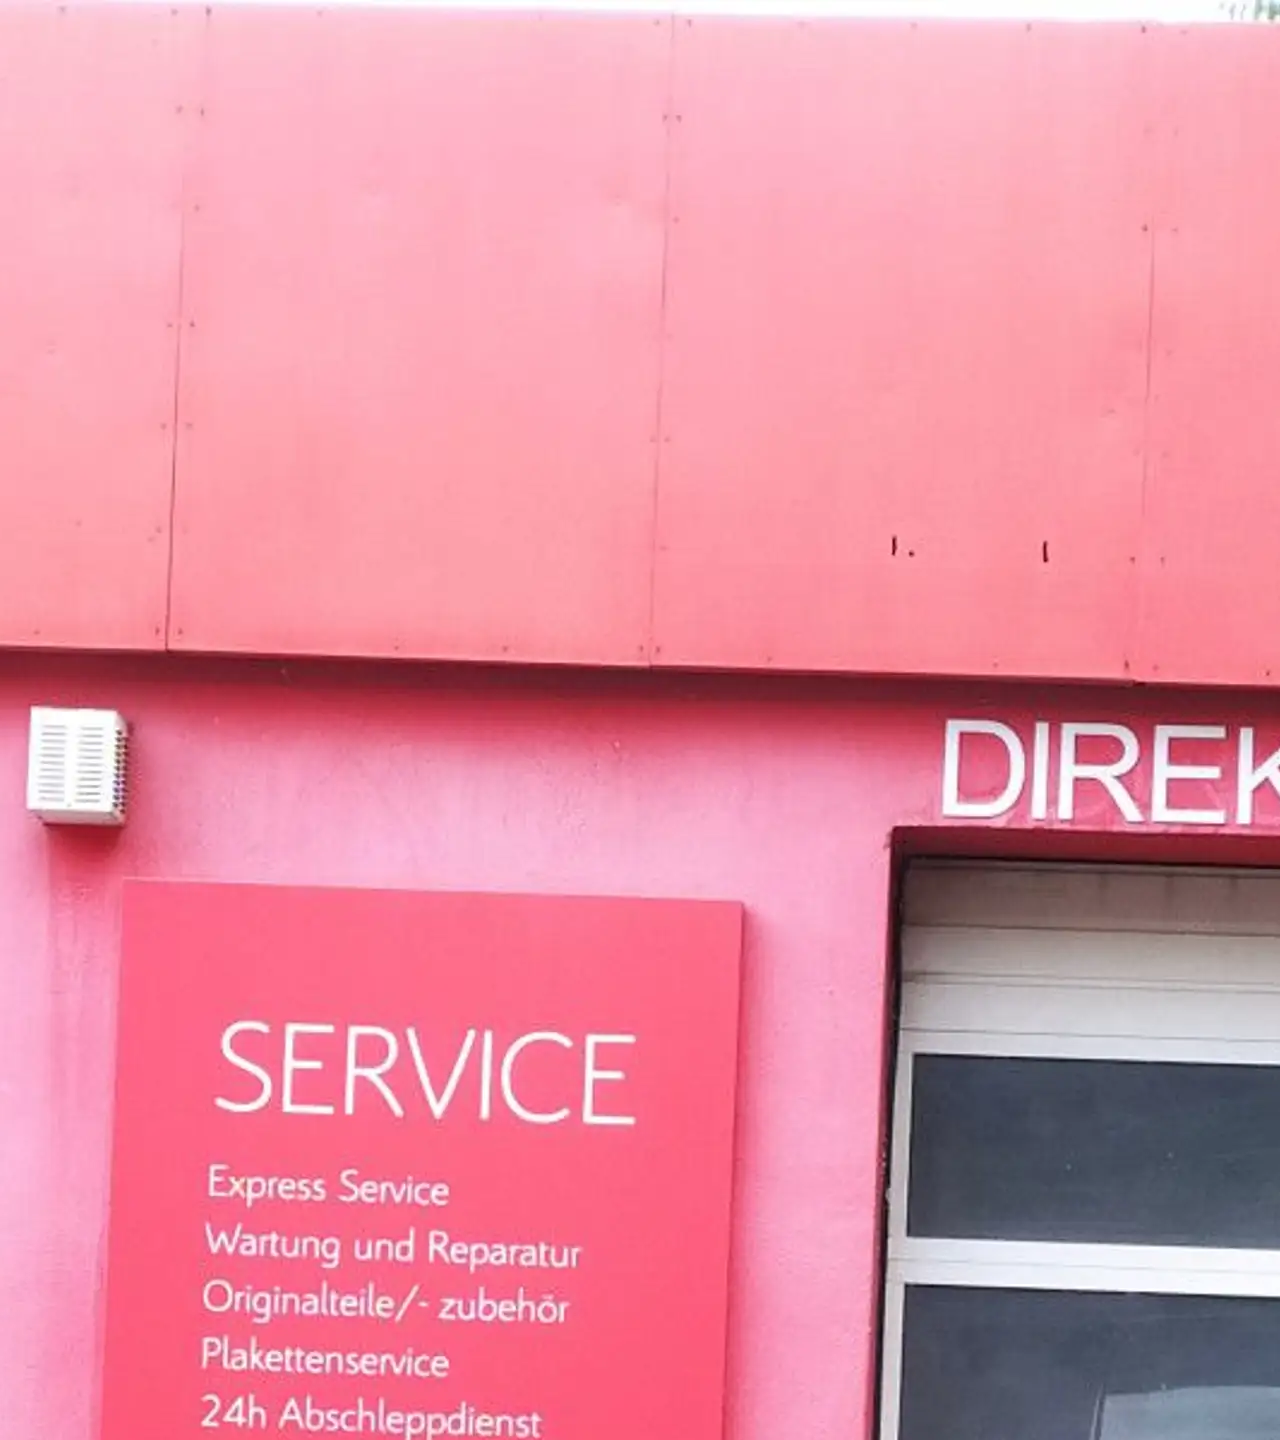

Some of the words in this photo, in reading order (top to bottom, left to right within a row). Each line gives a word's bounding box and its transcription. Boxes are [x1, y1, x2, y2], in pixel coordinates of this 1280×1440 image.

[214, 1020, 638, 1126] SERVICE
[207, 1163, 327, 1208] Express
[337, 1168, 451, 1207] Service
[204, 1222, 342, 1269] Wartung
[352, 1226, 416, 1263] und
[427, 1229, 583, 1274] Reparatur
[201, 1279, 430, 1324] Originalteile/-
[437, 1286, 571, 1324] zubehör
[200, 1335, 451, 1379] Plakettenservice
[199, 1392, 268, 1430] 24h
